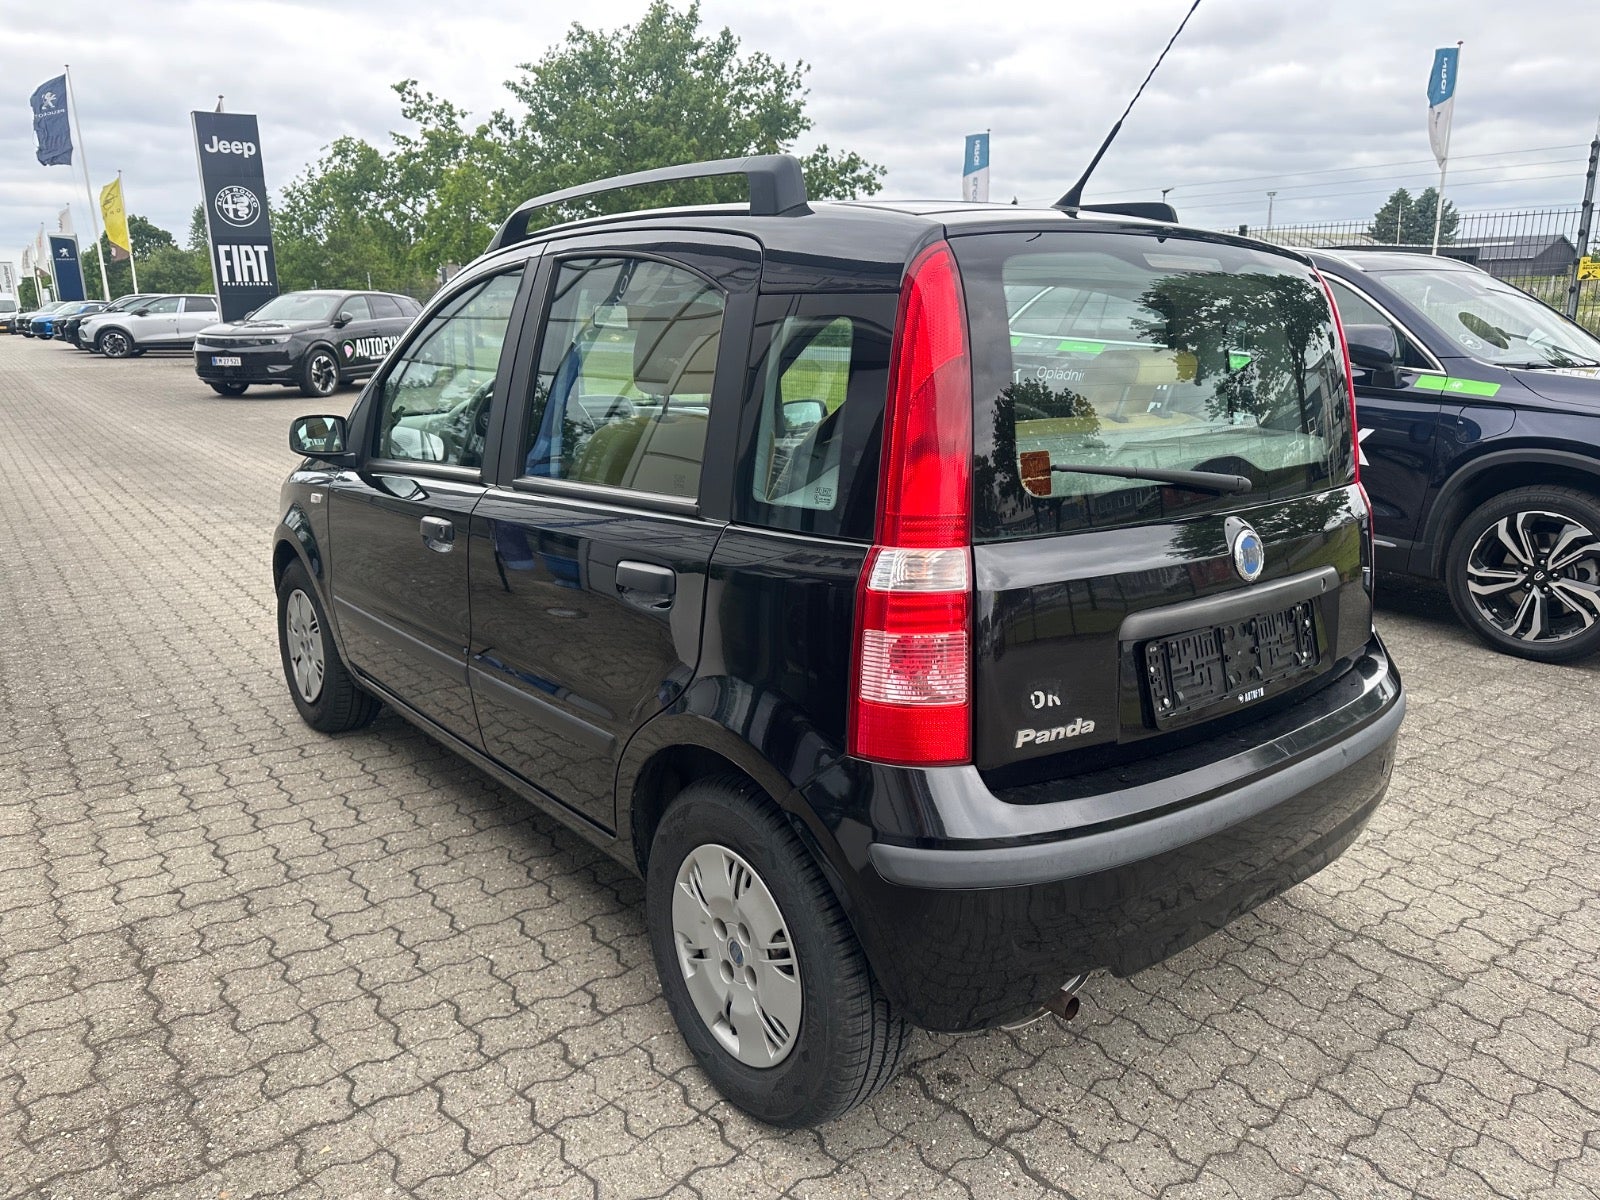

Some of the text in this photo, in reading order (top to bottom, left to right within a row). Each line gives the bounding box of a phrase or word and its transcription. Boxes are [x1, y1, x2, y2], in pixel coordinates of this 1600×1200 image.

[204, 135, 256, 158] Jeep
[217, 187, 258, 208] ALFA ROMEO
[217, 244, 269, 282] FIAT
[1015, 718, 1095, 748] Panda
